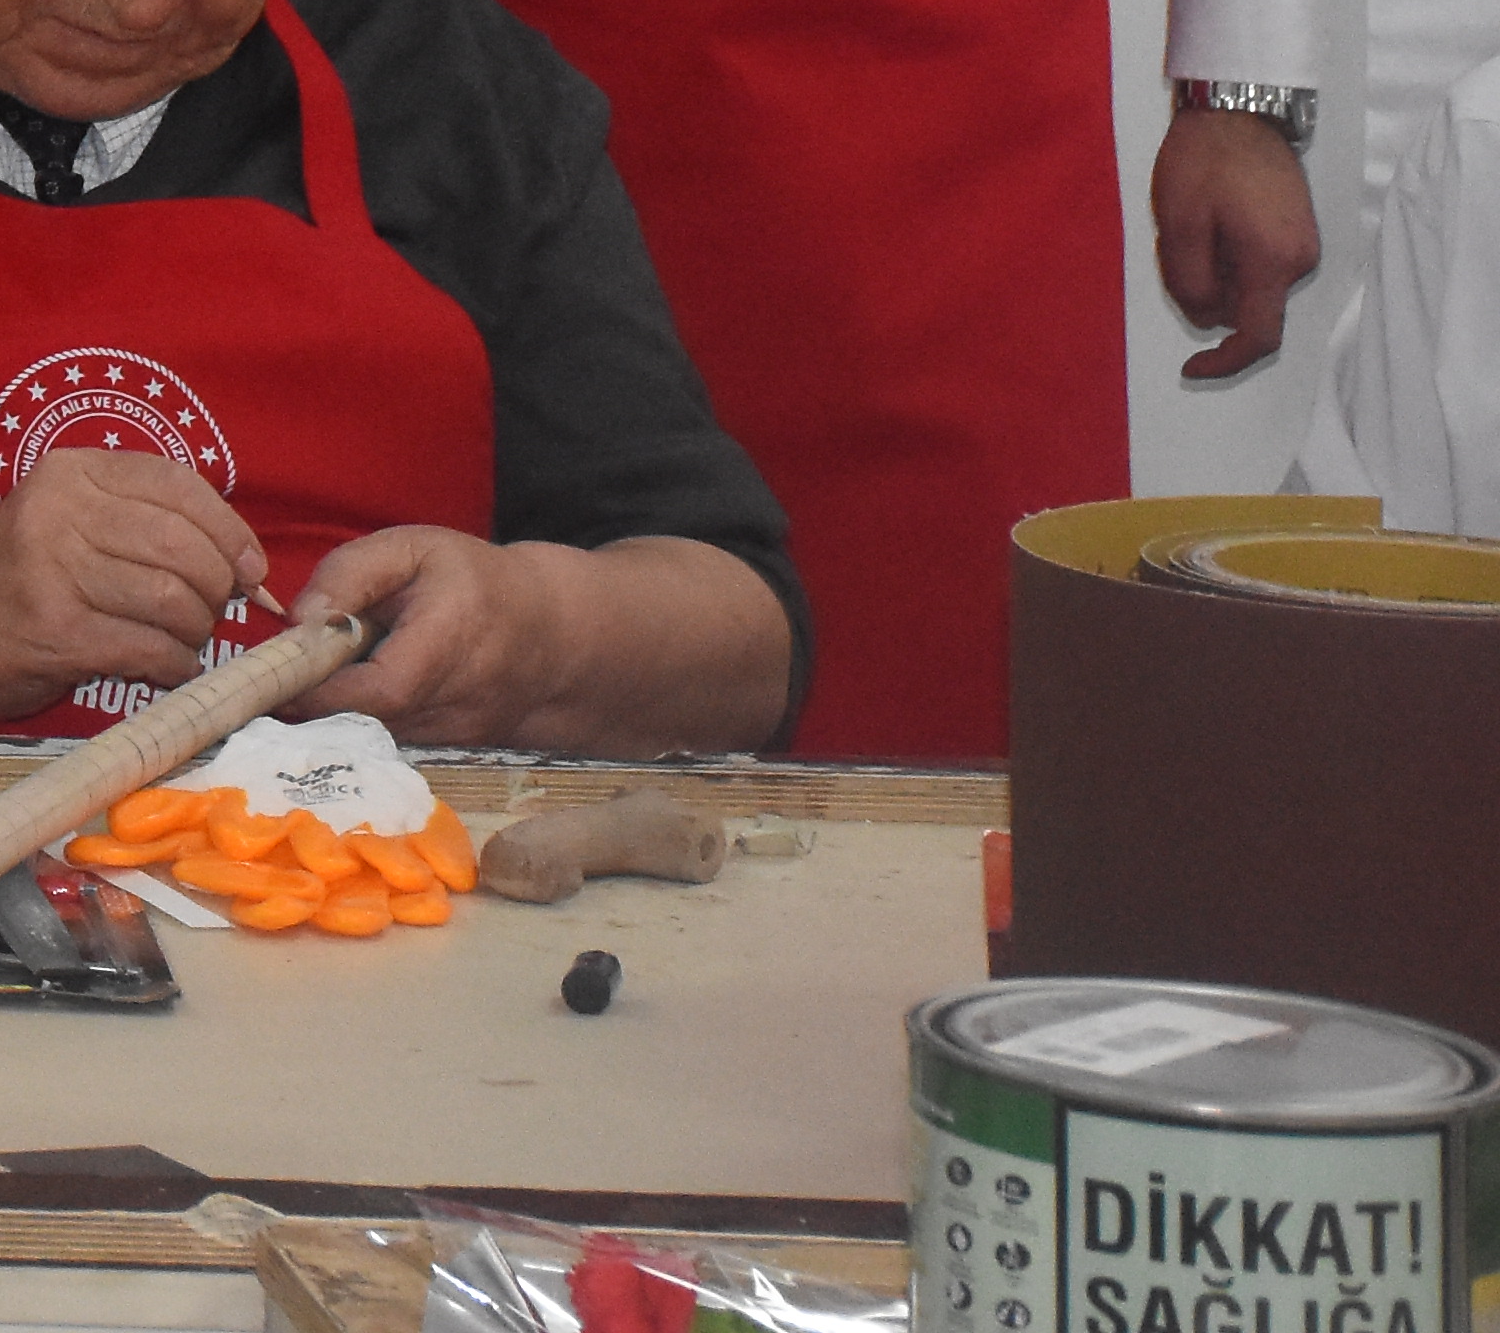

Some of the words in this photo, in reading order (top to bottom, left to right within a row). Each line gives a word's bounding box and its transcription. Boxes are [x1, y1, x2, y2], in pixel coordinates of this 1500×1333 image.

[20, 408, 62, 477] HURİYETİ
[62, 396, 91, 418] AİLE
[92, 395, 111, 409] VE
[114, 399, 162, 436] SOSYAL
[1084, 1171, 1423, 1275] DİKKAT!
